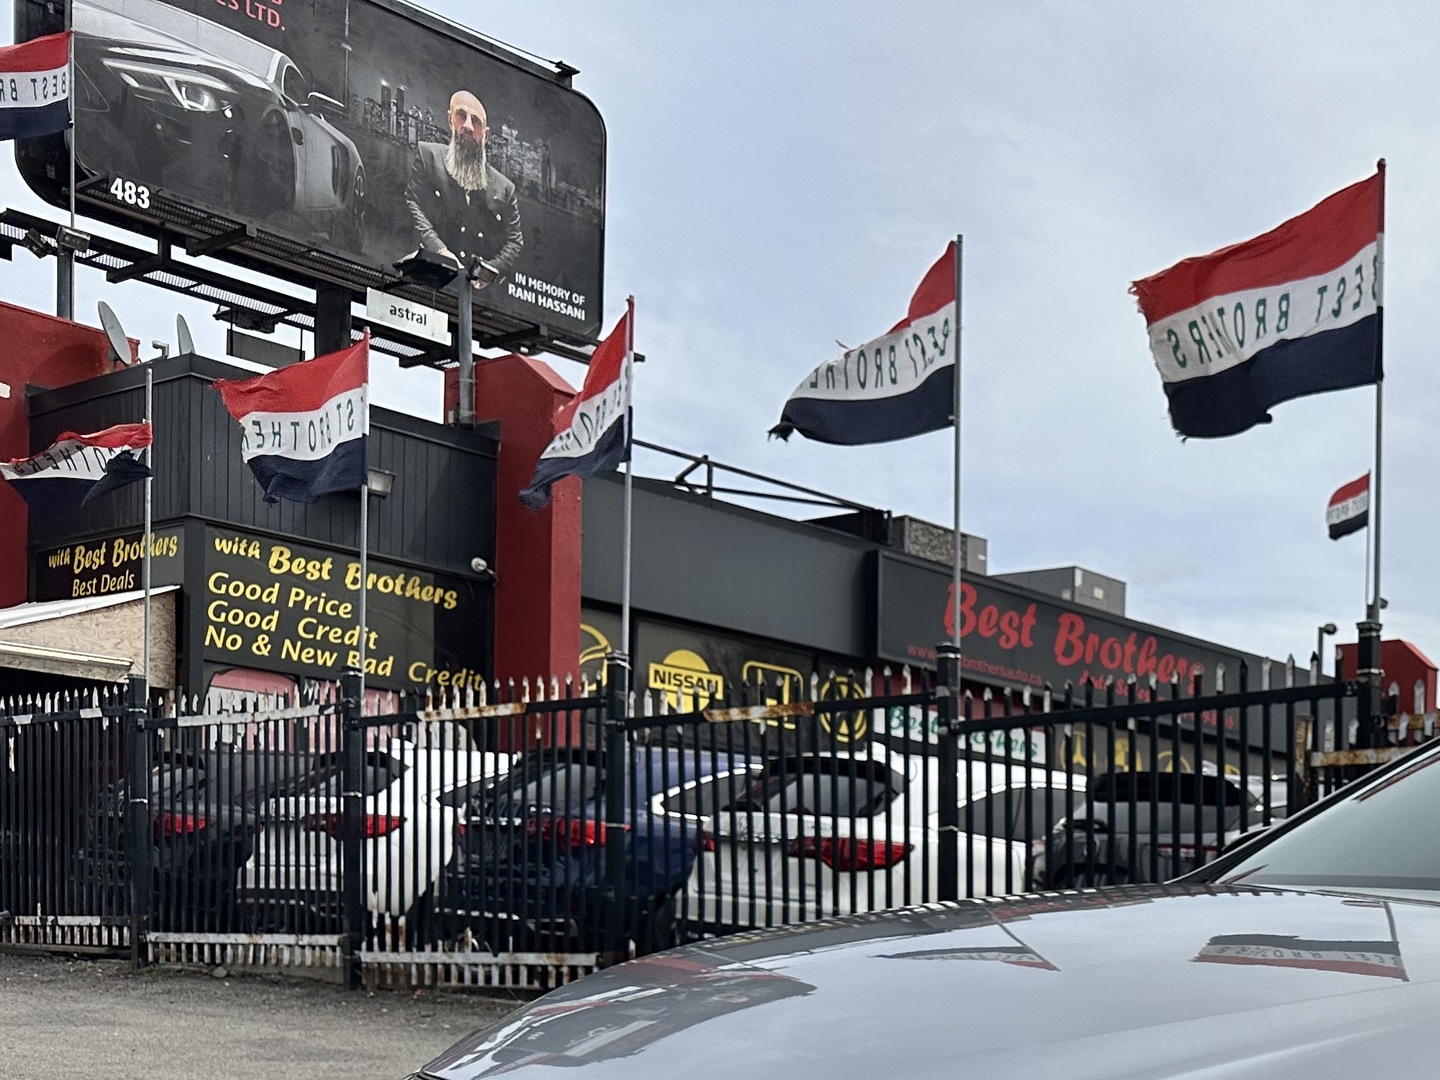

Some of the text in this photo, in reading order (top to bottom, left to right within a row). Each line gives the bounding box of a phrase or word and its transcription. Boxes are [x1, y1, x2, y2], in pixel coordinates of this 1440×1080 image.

[245, 0, 286, 31] LTD.
[110, 177, 150, 209] 483
[508, 283, 586, 321] RANI HASSANI
[515, 272, 586, 306] IN MEMORY OF
[389, 303, 427, 326] astral
[48, 532, 178, 574] with Best Brothers
[72, 569, 135, 598] Best Deals
[214, 537, 458, 610] with Best Brothers
[208, 571, 353, 619] Good Price
[207, 600, 379, 650] Good Credit
[943, 582, 1037, 650] Best
[204, 625, 485, 692] No & New Bad Credit
[907, 645, 1043, 685] wwwbrothersauto.ca
[653, 669, 718, 693] NISSAN
